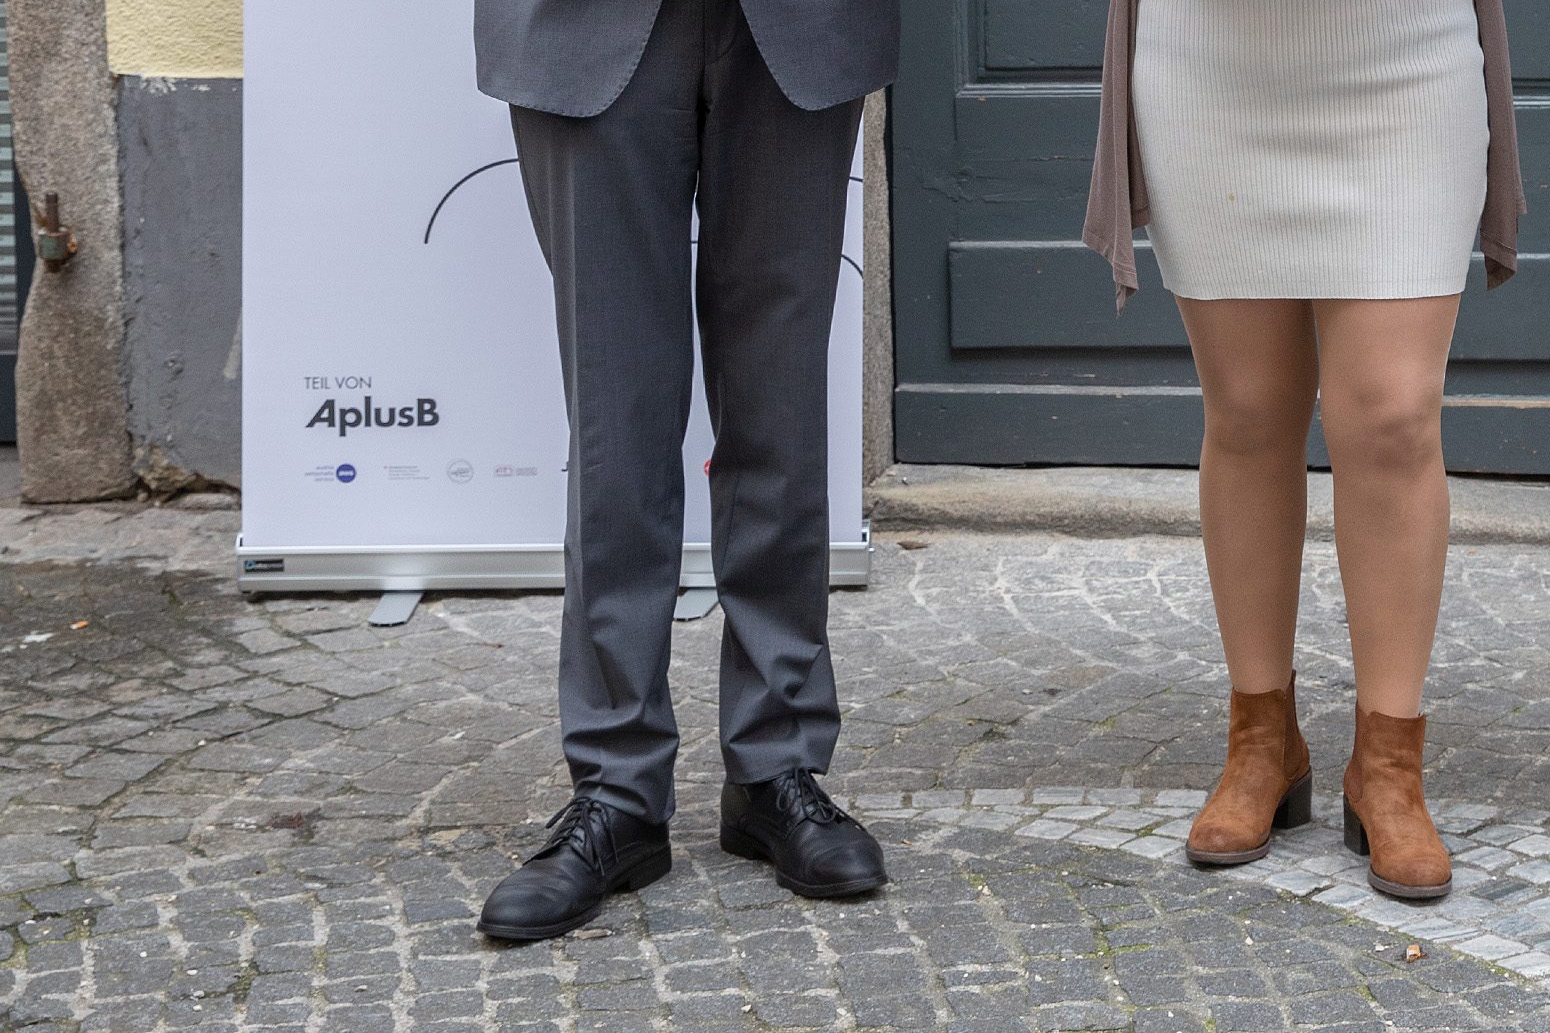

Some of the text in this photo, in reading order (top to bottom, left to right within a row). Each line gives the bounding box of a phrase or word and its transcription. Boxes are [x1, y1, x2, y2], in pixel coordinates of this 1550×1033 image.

[304, 376, 372, 390] TEIL VON
[305, 396, 440, 437] AplusB
